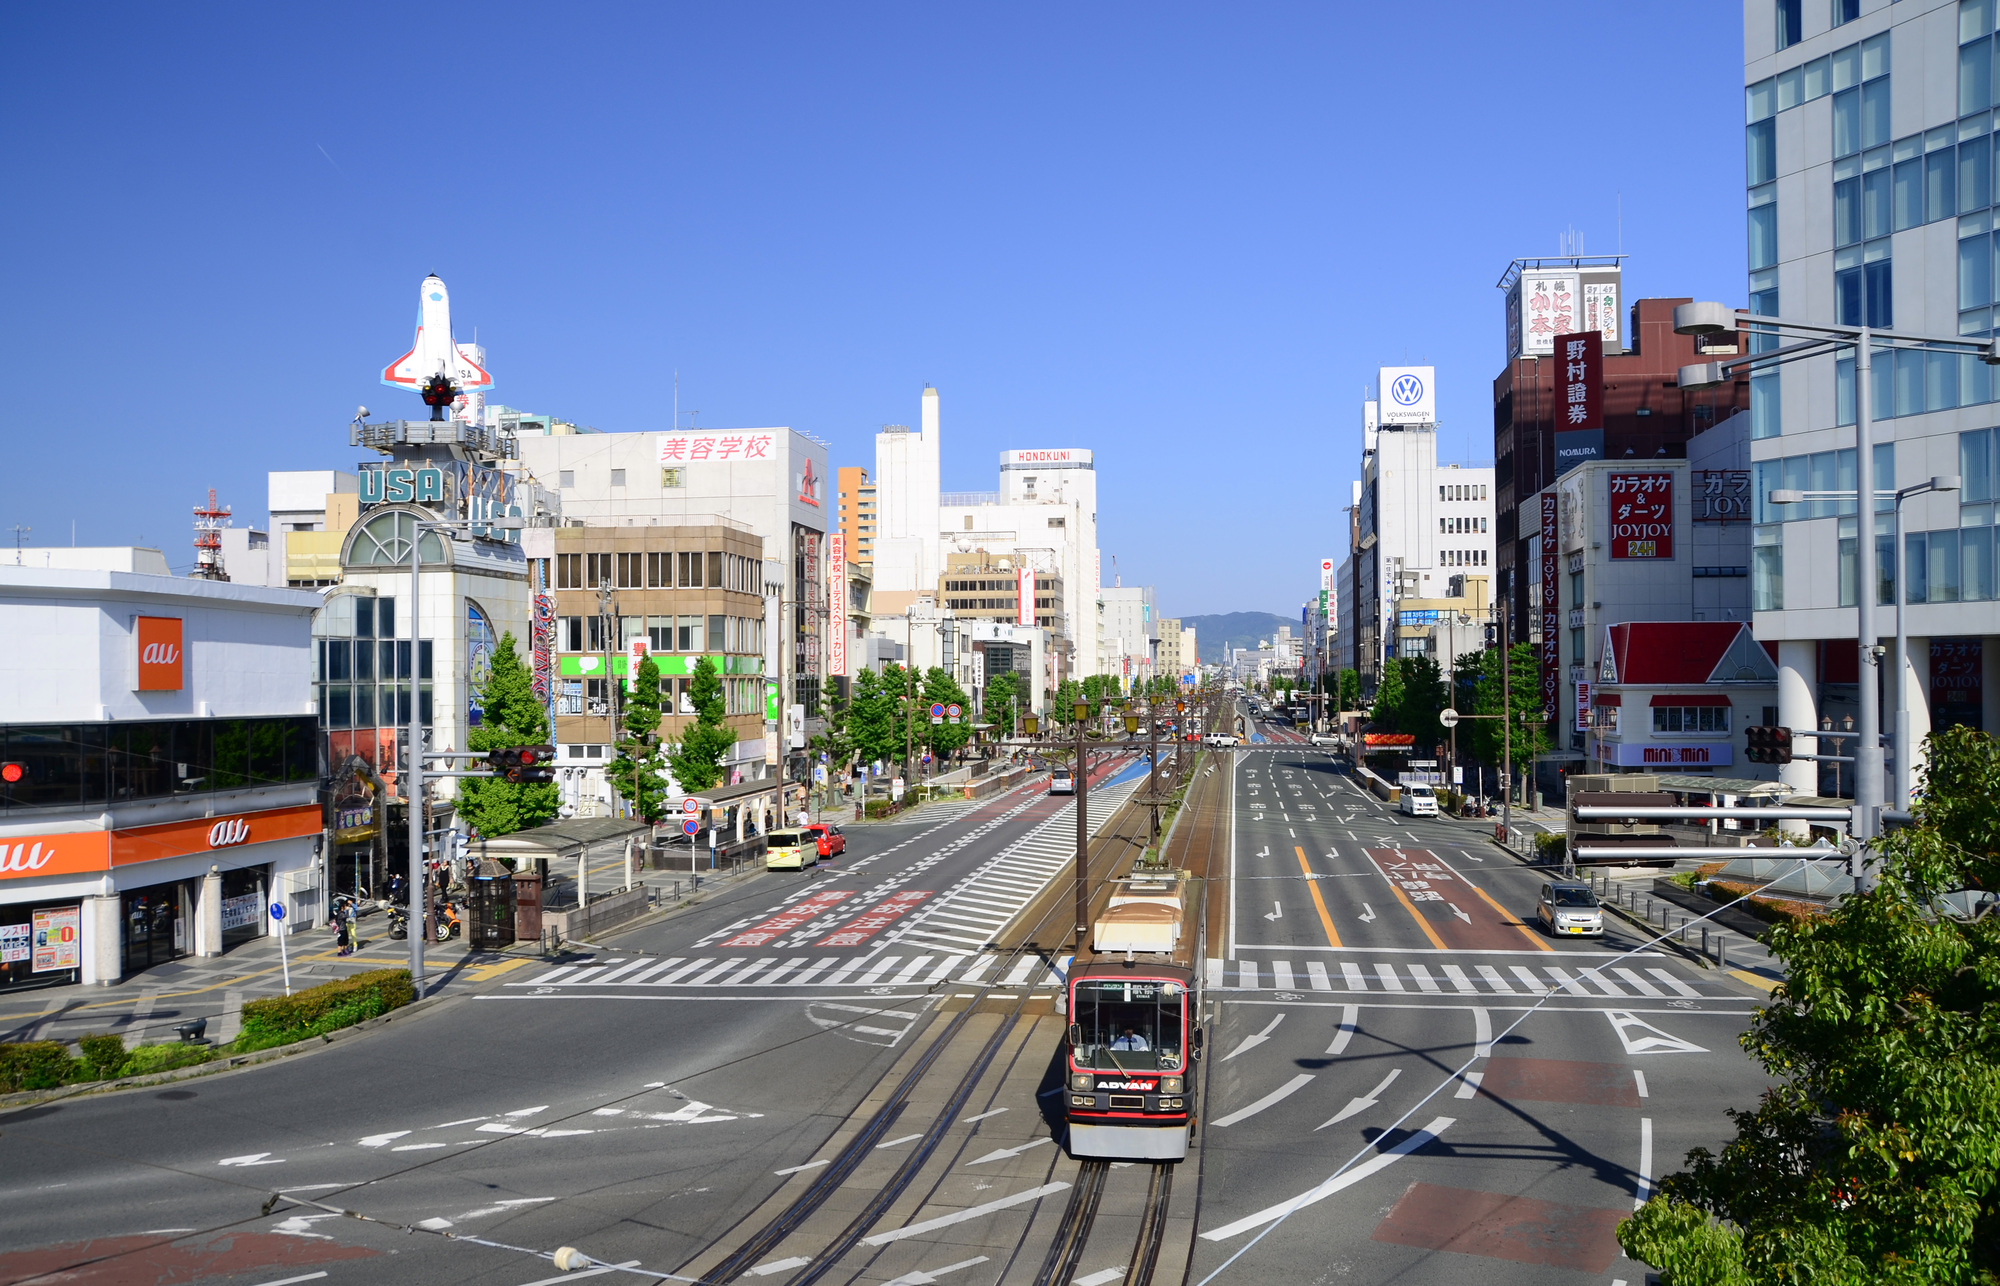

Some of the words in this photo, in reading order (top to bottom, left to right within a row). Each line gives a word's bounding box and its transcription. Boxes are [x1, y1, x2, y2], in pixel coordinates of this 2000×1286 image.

[1529, 291, 1572, 313] かに
[1529, 313, 1574, 336] 本家
[1603, 295, 1615, 339] カラオケ
[1566, 339, 1588, 425] 野村證券
[661, 434, 772, 461] 美容学校
[1018, 451, 1070, 461] HONOKUNI
[1559, 447, 1597, 457] NOMURA
[358, 467, 444, 504] USA
[1611, 475, 1671, 494] カラオケ
[1704, 473, 1750, 495] カラ
[1636, 492, 1646, 504] &
[1702, 495, 1750, 518] JOY
[1542, 496, 1556, 549] カラオケ
[1617, 503, 1666, 521] ダーツ
[1611, 523, 1672, 541] JOYJOY
[832, 536, 842, 573] 美容学校
[1629, 541, 1655, 557] 24H
[1544, 556, 1556, 605] JOYJOY
[1544, 610, 1557, 665] カラオケ
[142, 641, 180, 665] au
[1930, 643, 1984, 656] カラオケ
[1938, 661, 1975, 674] ダーツ
[1930, 675, 1982, 690] JOYJOY
[1544, 671, 1556, 721] JOYJOY
[1643, 747, 1672, 763] mini
[1680, 747, 1710, 763] mini
[685, 802, 695, 810] 50
[208, 818, 251, 848] au
[723, 890, 854, 947] 事故注意
[819, 890, 934, 947] 事故注意
[1096, 1081, 1153, 1091] ADVAN
